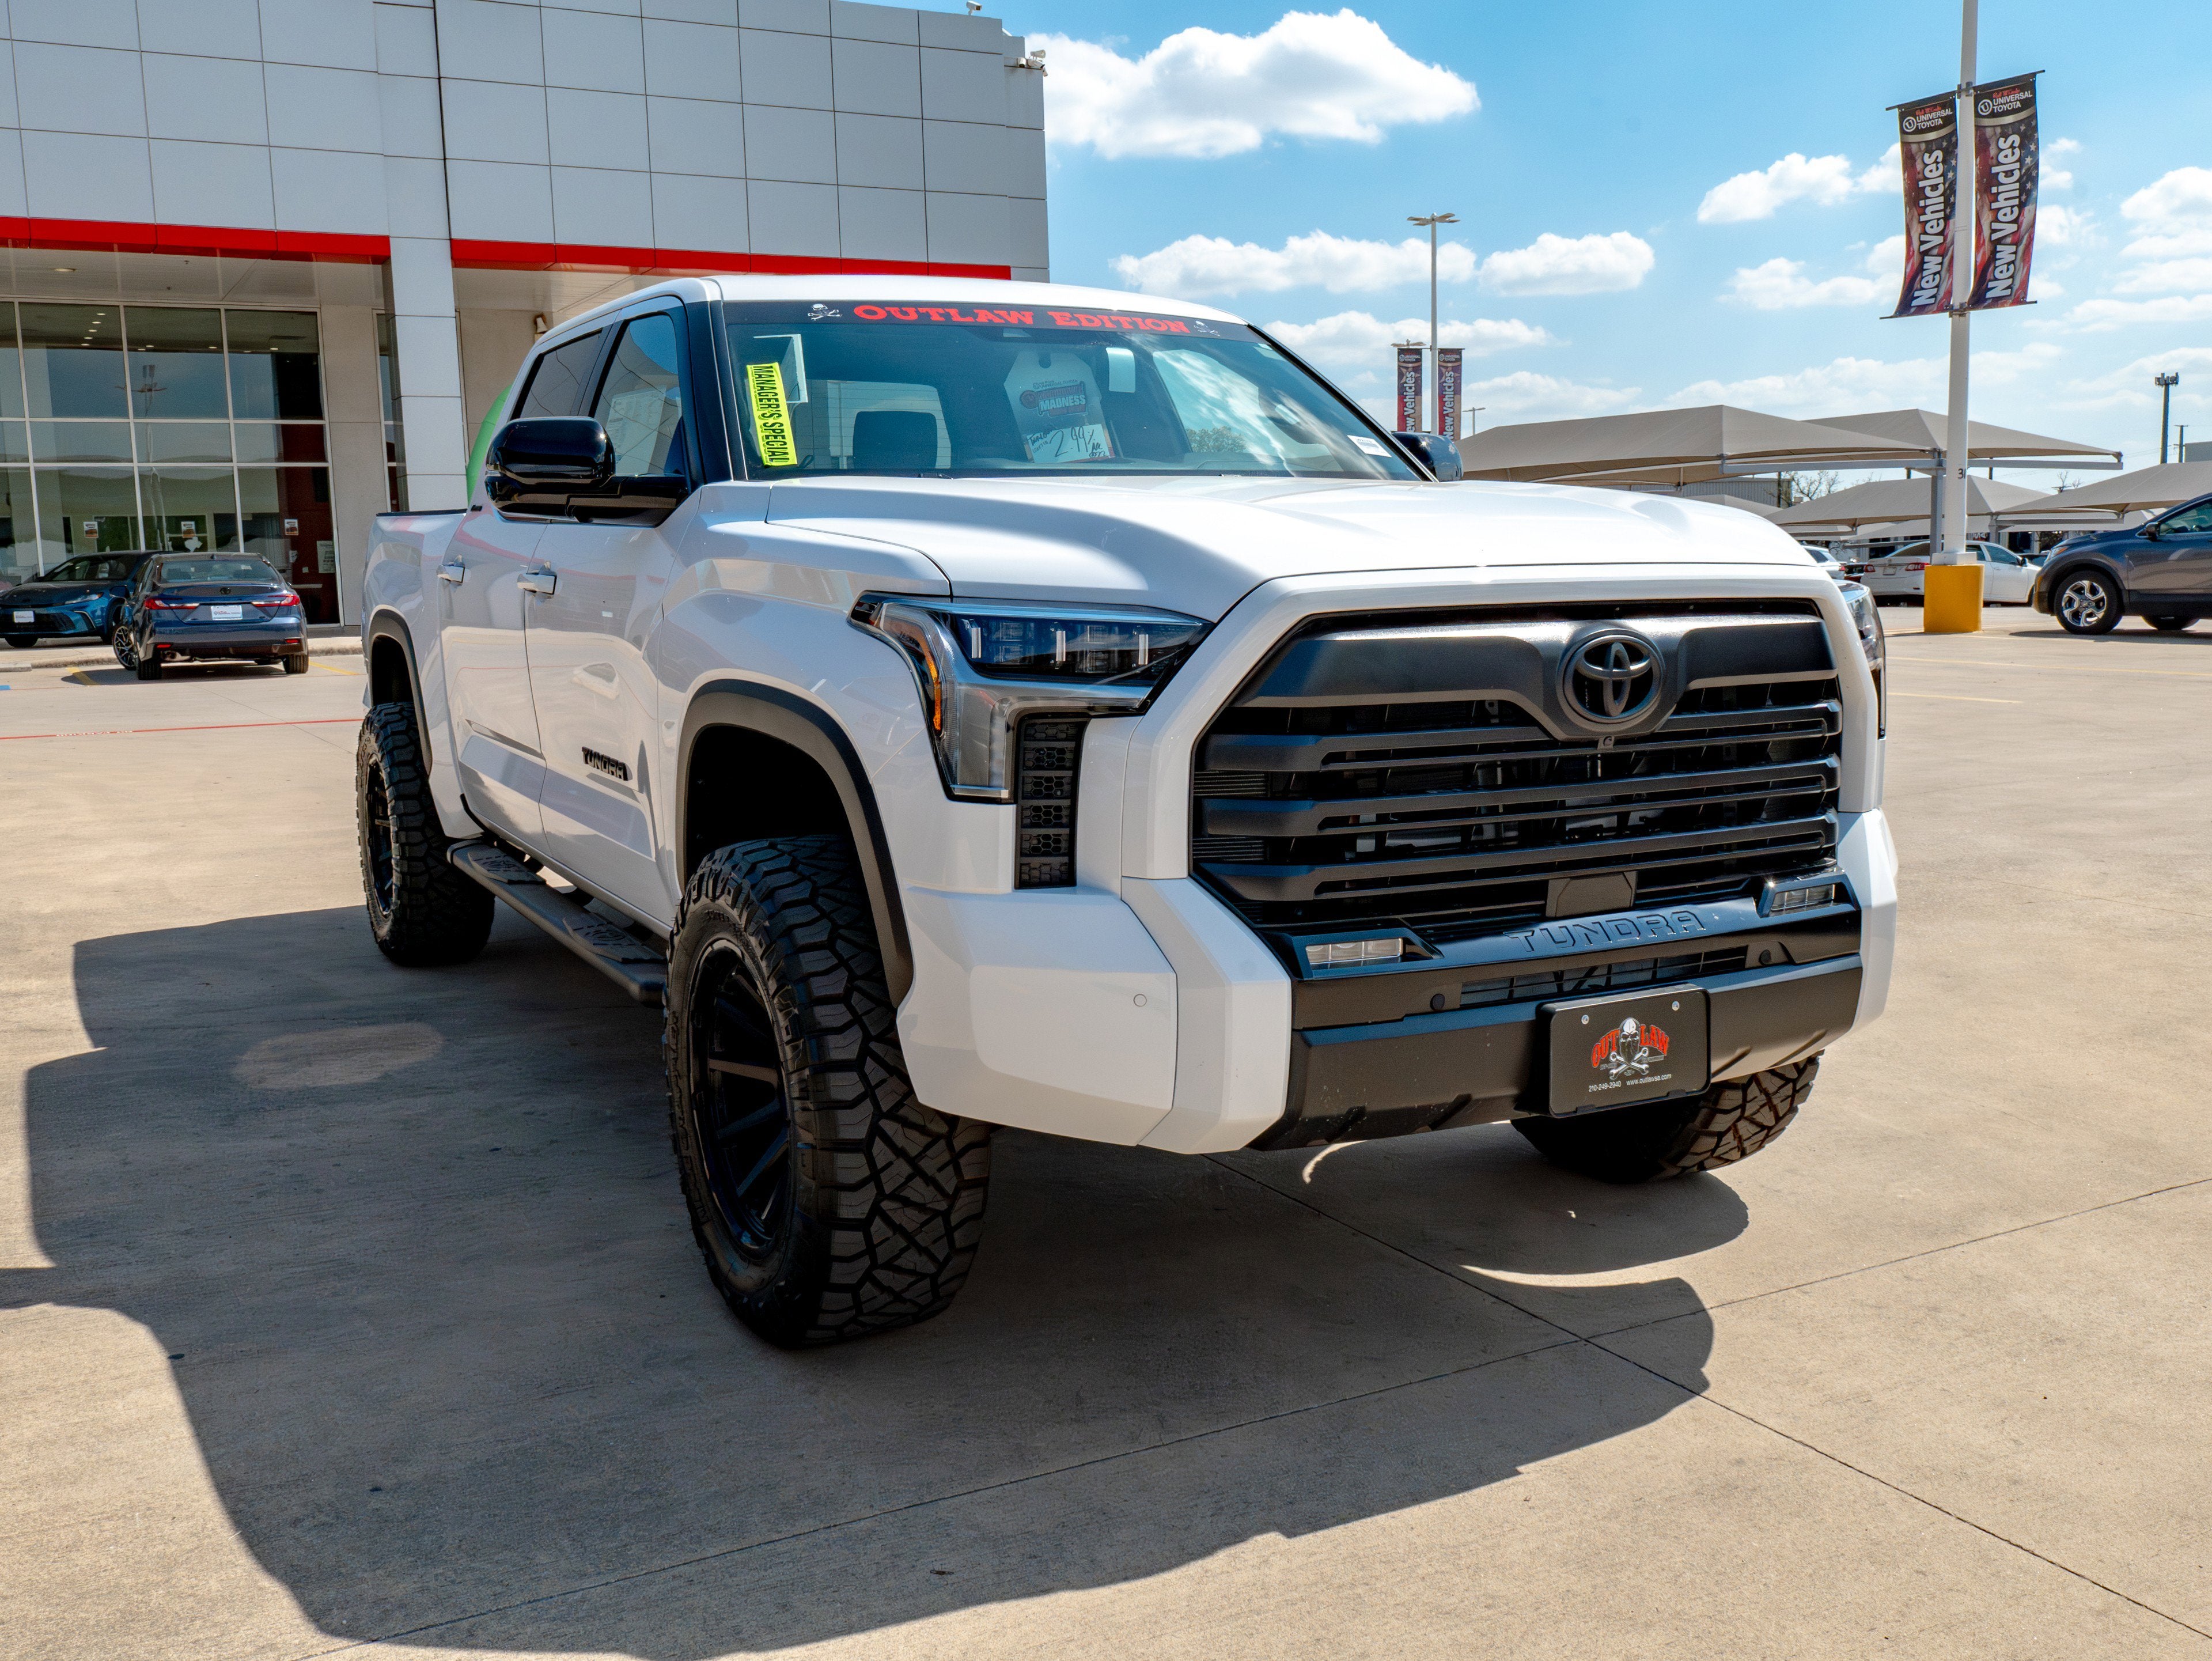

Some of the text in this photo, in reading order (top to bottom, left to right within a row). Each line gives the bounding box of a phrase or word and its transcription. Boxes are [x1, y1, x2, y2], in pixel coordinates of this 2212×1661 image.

[1993, 90, 2033, 105] UNIVERSAL
[1993, 101, 2021, 113] TOYOTA
[1916, 108, 1953, 122] UNIVERSAL
[1917, 119, 1943, 130] TOYOTA
[1911, 150, 1944, 307] New Vehicles
[1986, 134, 2021, 300] New Vehicles
[854, 305, 1191, 333] OUTLAW EDITION
[753, 365, 790, 463] MANAGER'S SPECIAL
[1039, 395, 1086, 411] MADNESS
[1404, 371, 1415, 432] ew Vehicles
[1442, 370, 1455, 440] New Vehicles
[582, 746, 628, 781] TUNDRA
[1503, 910, 1706, 952] TUNDRA
[1589, 1074, 1672, 1092] 210-249-2940 www.outlawsa.com
